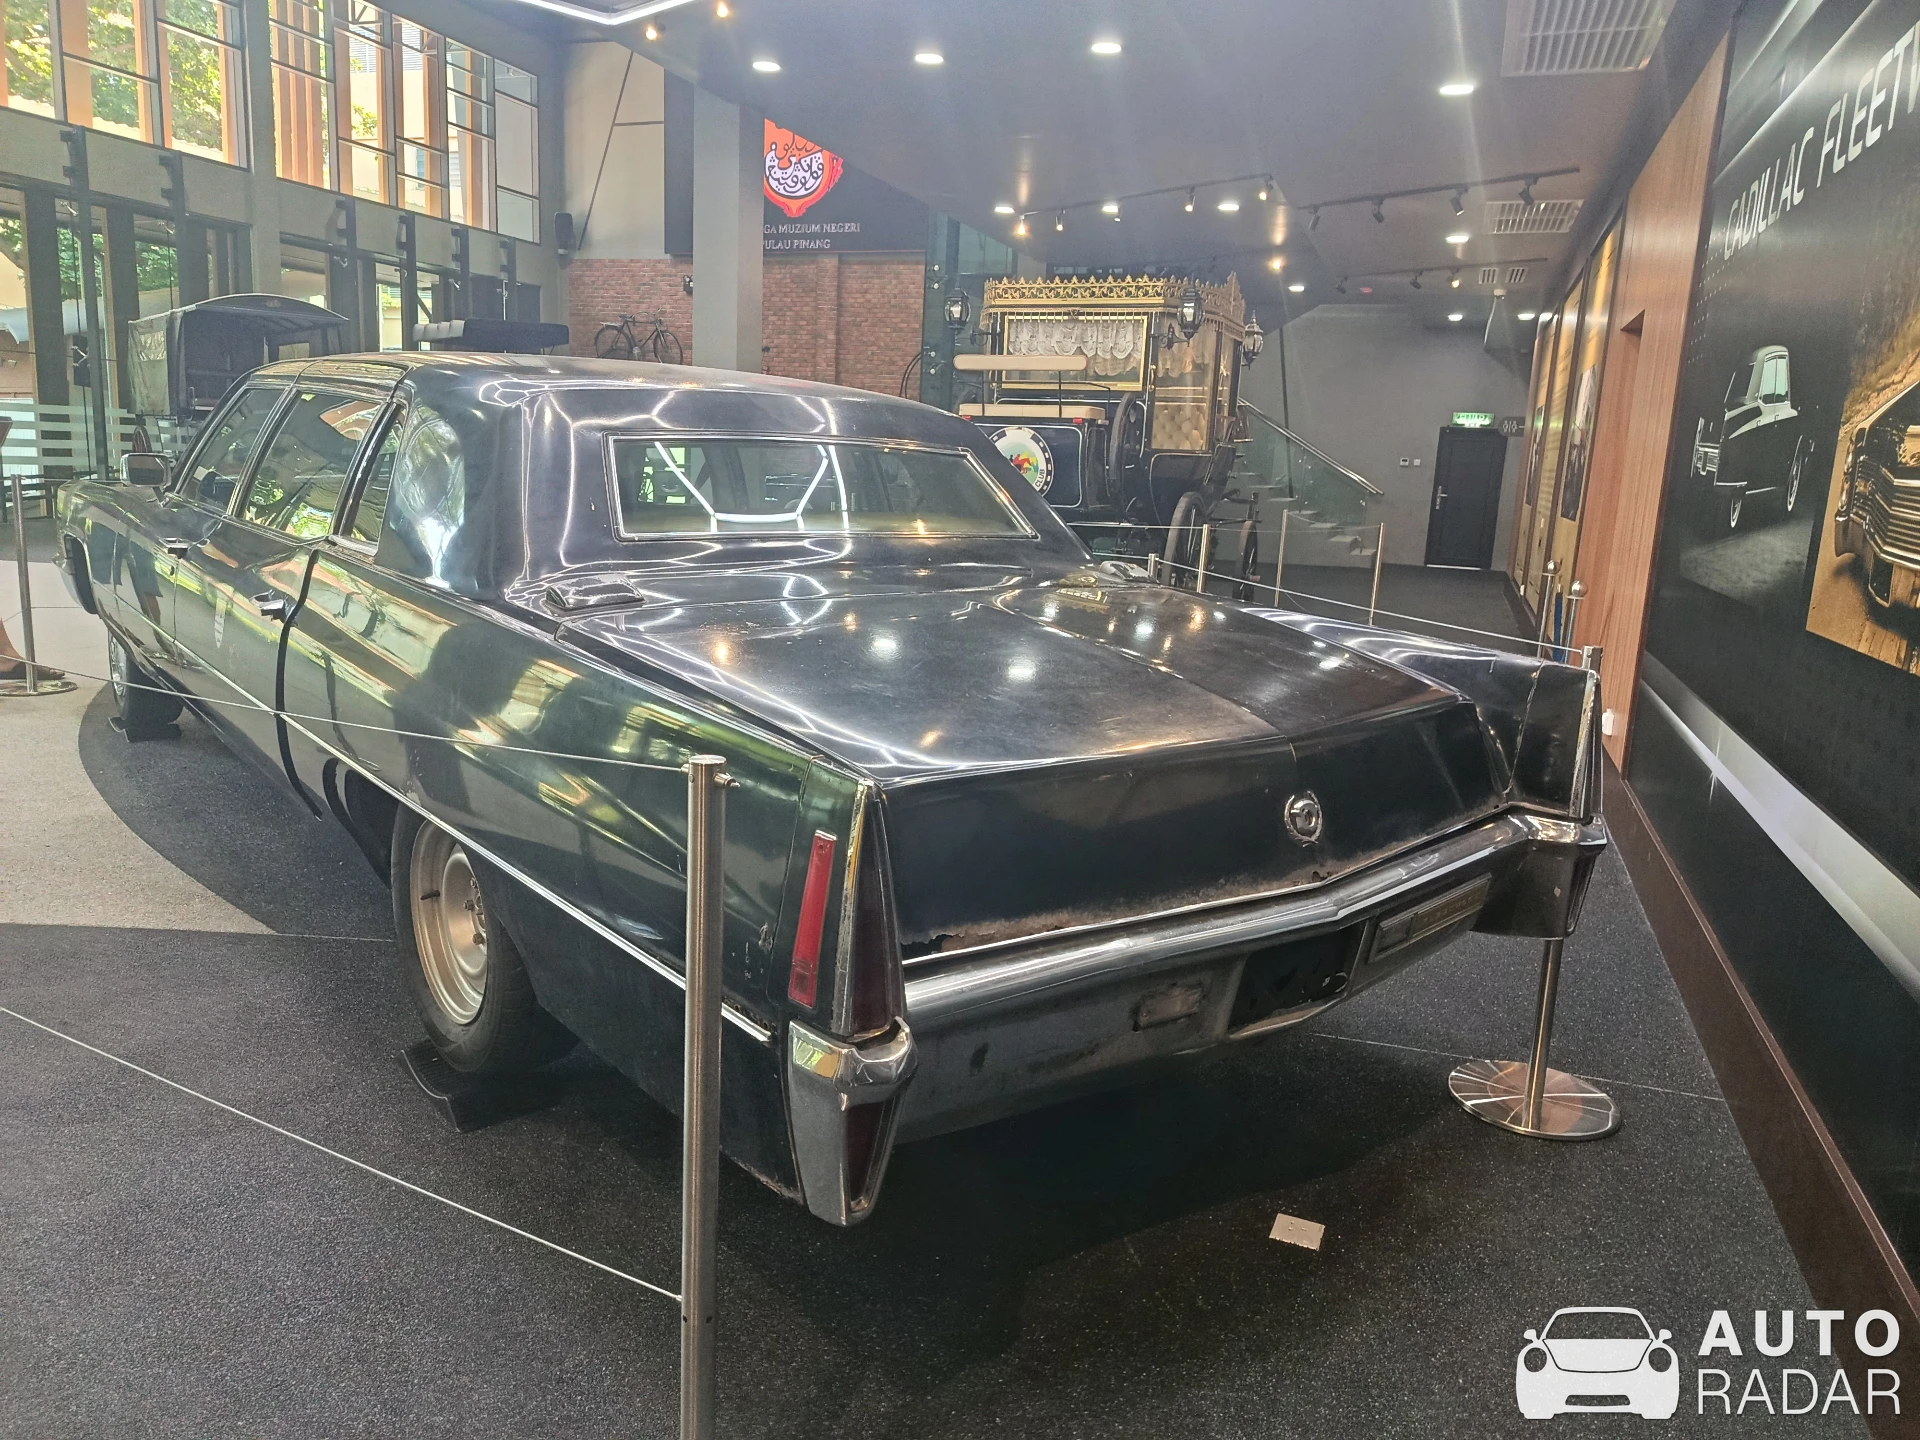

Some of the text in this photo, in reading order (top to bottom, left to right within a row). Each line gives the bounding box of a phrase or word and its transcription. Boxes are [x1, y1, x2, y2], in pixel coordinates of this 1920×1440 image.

[1724, 127, 1814, 261] CADILLAC
[764, 222, 860, 234] GA MUZIUM NEGERI
[763, 238, 831, 250] ULAU PINANG
[1035, 468, 1045, 487] CLUB
